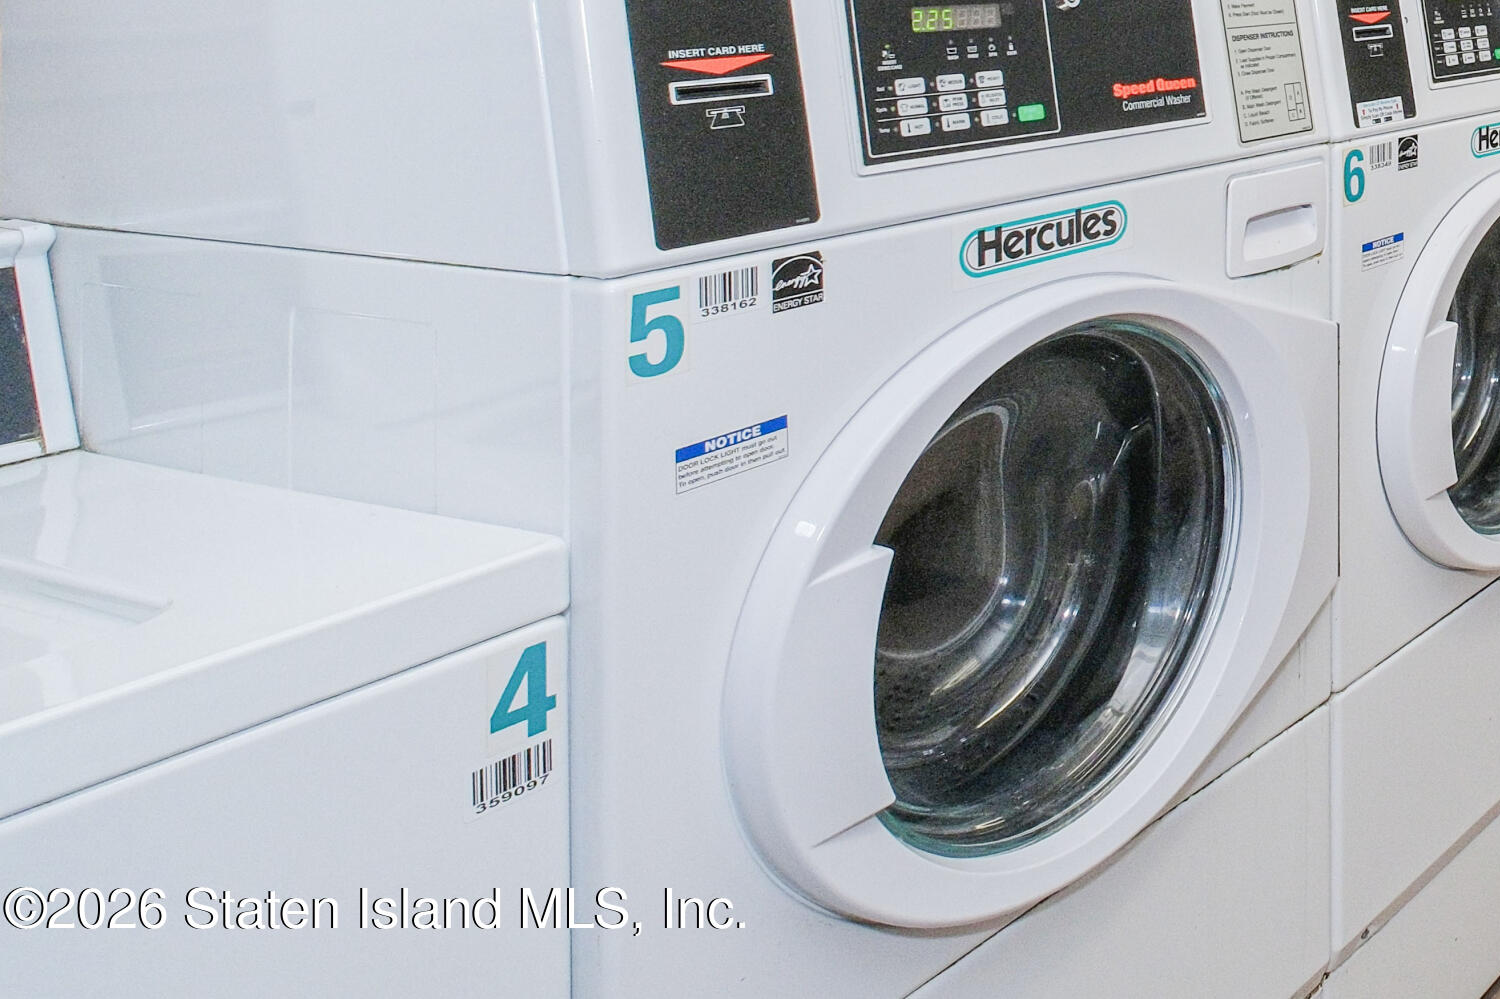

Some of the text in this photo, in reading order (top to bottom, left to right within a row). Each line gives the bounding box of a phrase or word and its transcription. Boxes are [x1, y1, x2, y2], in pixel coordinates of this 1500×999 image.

[912, 8, 954, 32] 2.25
[668, 44, 765, 58] INSERT CARD HERE
[1112, 77, 1197, 98] Speed Queen
[1122, 94, 1191, 111] Commercial Washer
[1344, 149, 1365, 202] 6
[977, 208, 1117, 267] Hercules
[1372, 236, 1394, 249] NOTICE
[701, 297, 757, 317] 338162
[773, 293, 823, 312] ENERGY STAR
[628, 285, 685, 378] 5
[704, 425, 762, 452] NOTICE
[678, 461, 698, 472] DOOR
[700, 455, 718, 464] LOCK
[720, 448, 740, 456] LIGHT
[678, 470, 698, 480] before
[700, 460, 734, 472] attempting
[742, 450, 758, 458] open
[725, 465, 738, 473] door
[490, 640, 556, 738] 4
[476, 774, 550, 814] 359097
